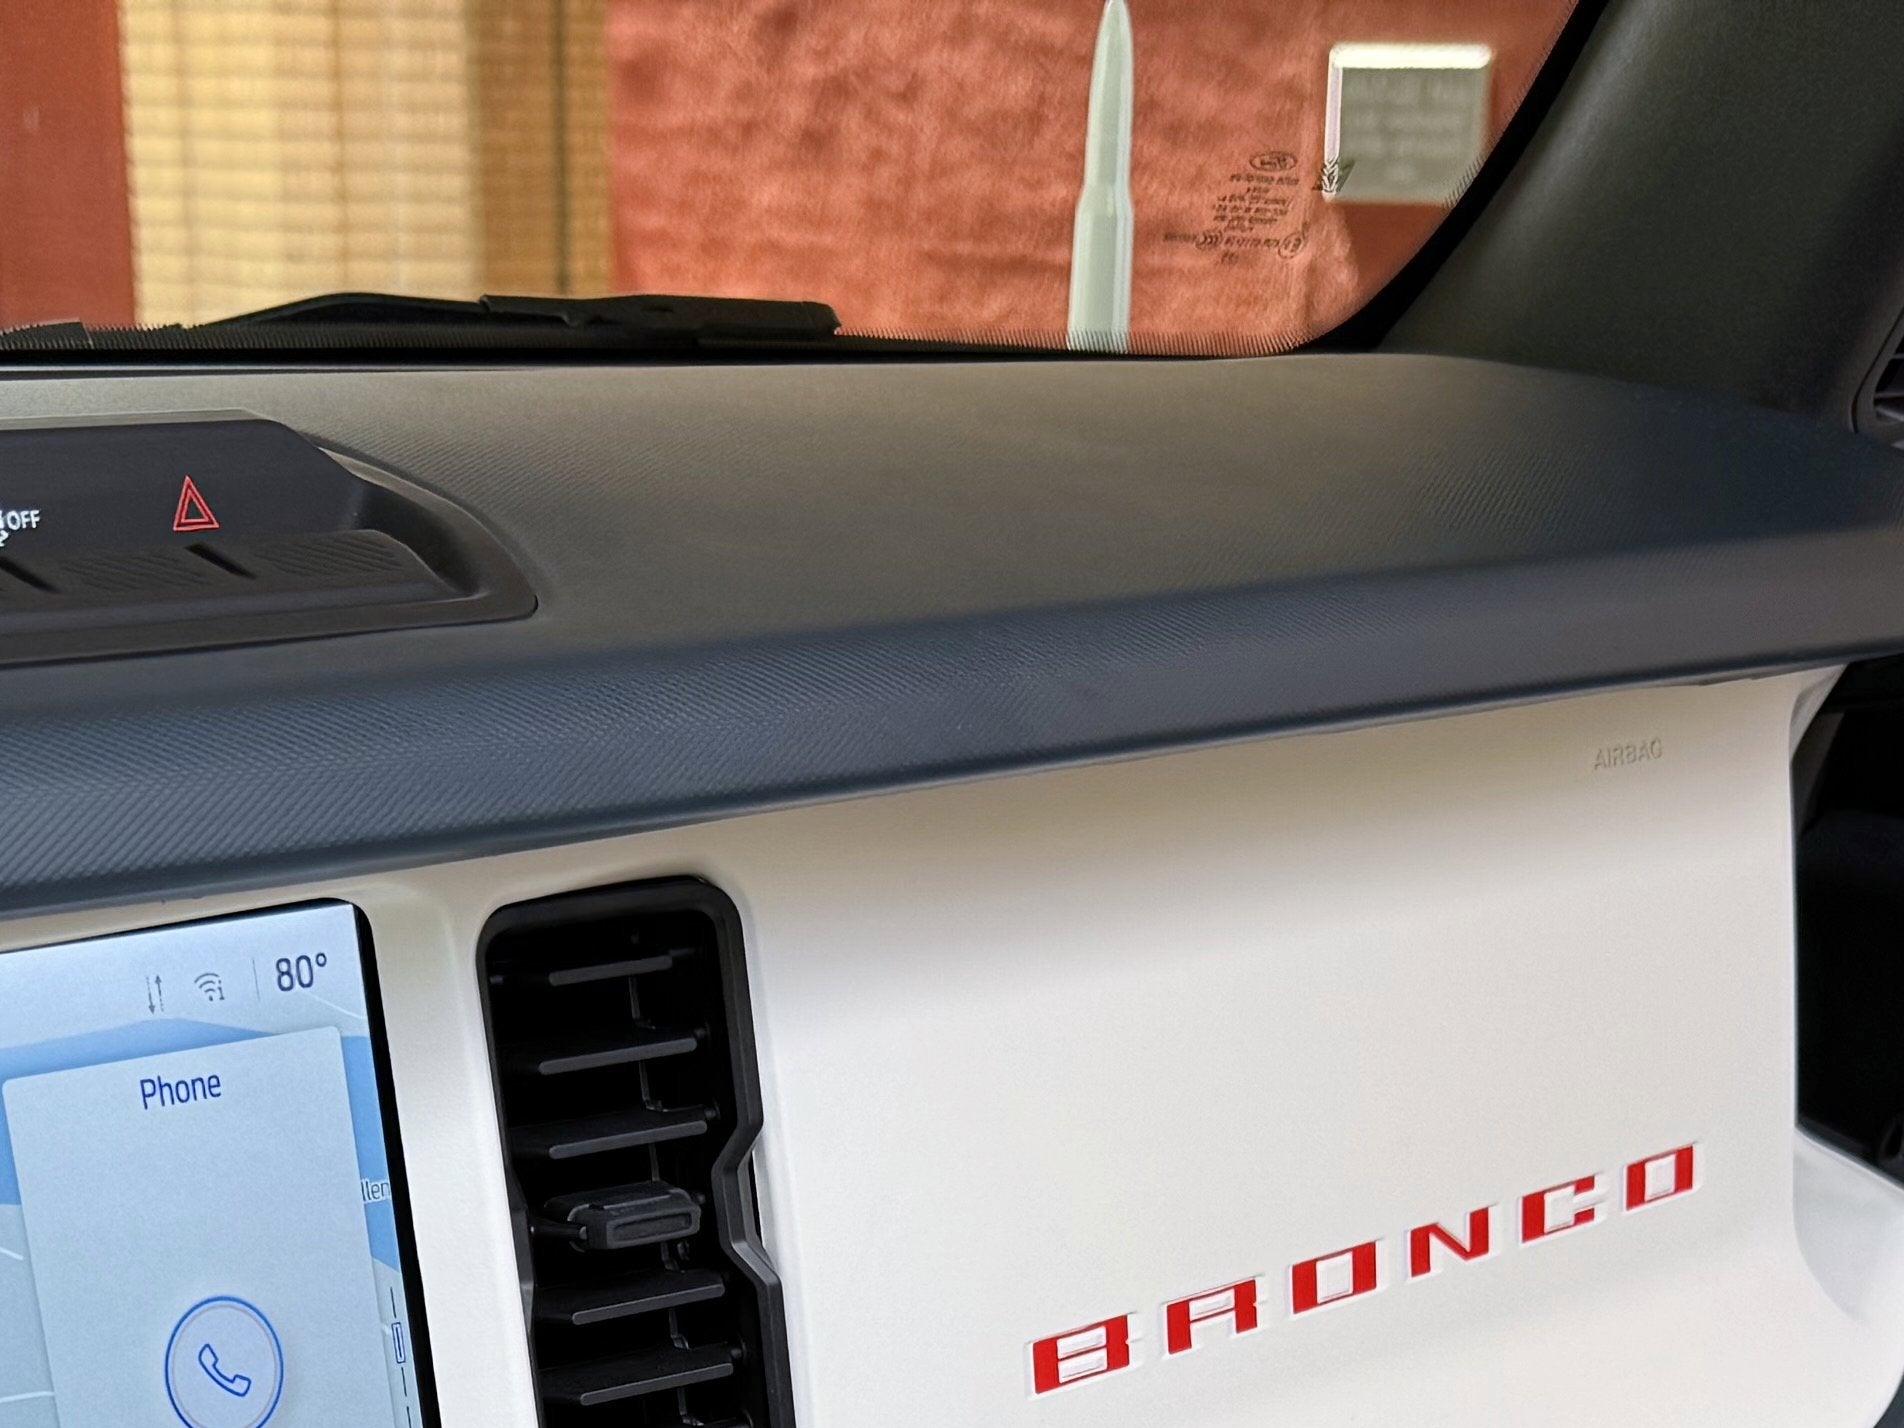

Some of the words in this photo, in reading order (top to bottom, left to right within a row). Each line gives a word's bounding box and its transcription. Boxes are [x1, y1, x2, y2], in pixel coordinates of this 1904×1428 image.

[6, 509, 40, 530] OFF
[275, 952, 328, 995] 80°
[139, 1070, 223, 1110] Phone
[1028, 1142, 1698, 1397] BRONCO
